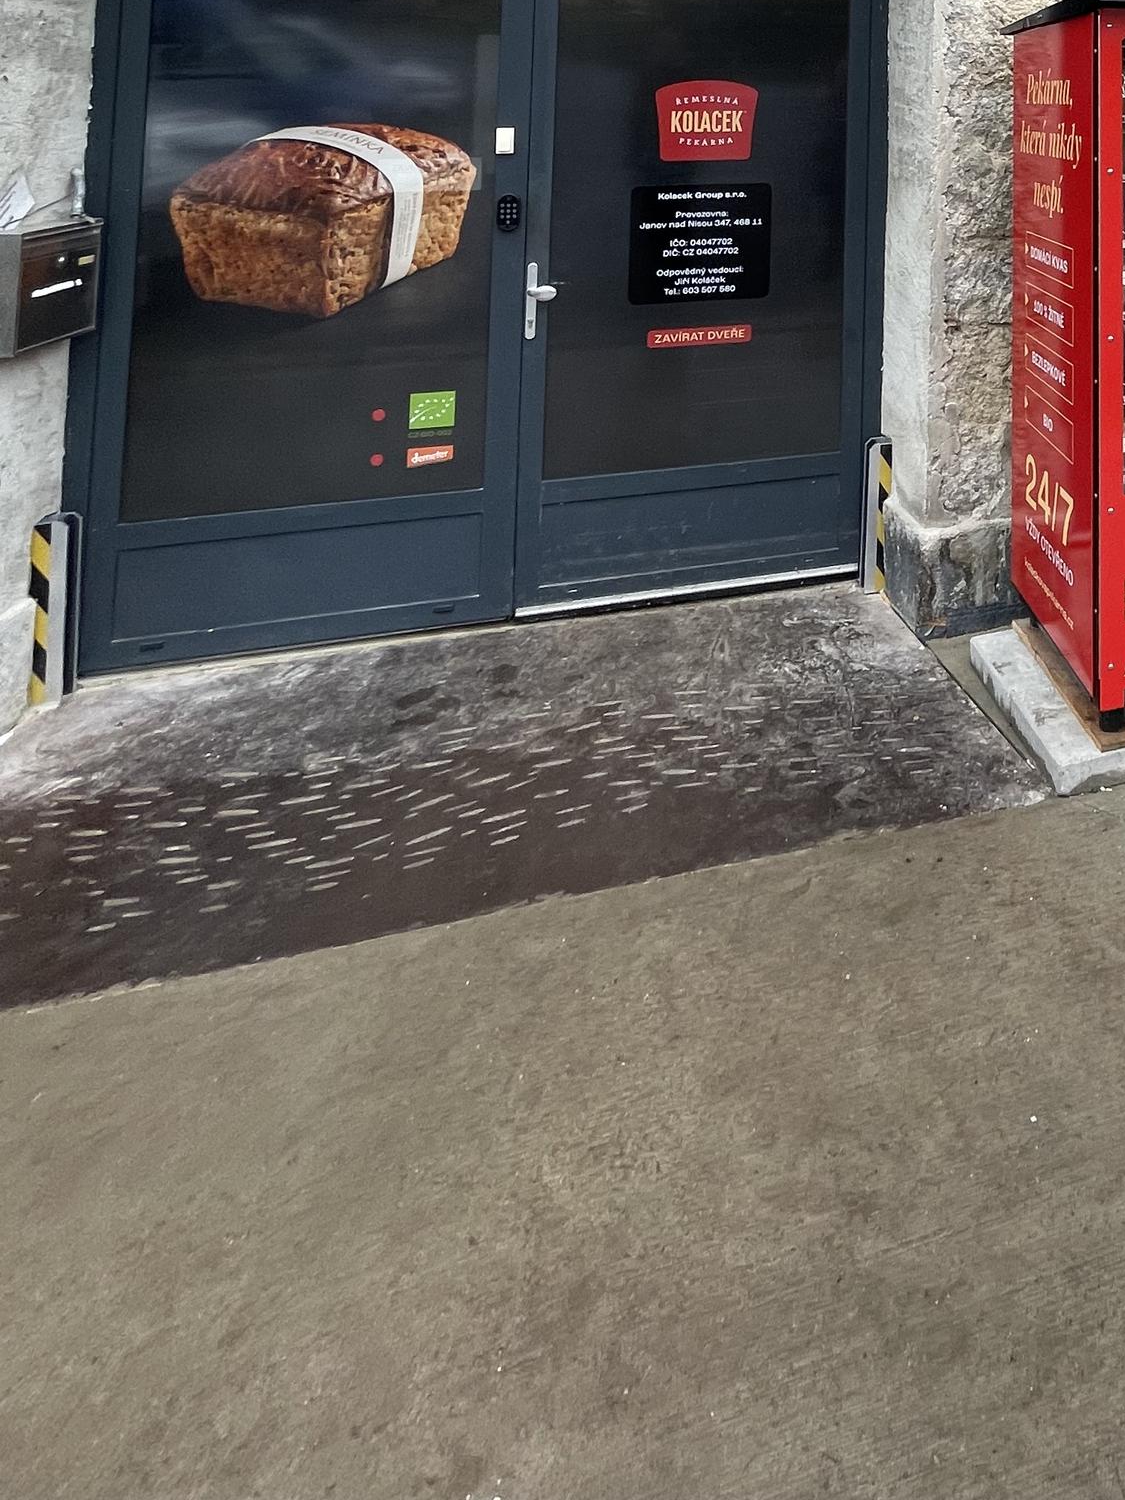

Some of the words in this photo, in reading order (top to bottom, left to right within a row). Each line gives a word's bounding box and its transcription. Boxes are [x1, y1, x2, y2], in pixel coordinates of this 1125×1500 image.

[1026, 67, 1073, 111] Pekárna,
[1020, 120, 1047, 157] která
[1049, 122, 1082, 170] nikdy
[694, 191, 724, 200] Group
[1033, 174, 1064, 219] nespí.
[639, 221, 667, 230] Janov
[668, 220, 686, 228] nad
[752, 218, 763, 226] 11
[682, 248, 695, 256] CZ
[654, 331, 705, 344] ZAVÍRAT
[707, 327, 745, 340] DVEŘE
[1025, 453, 1074, 546] 24/7
